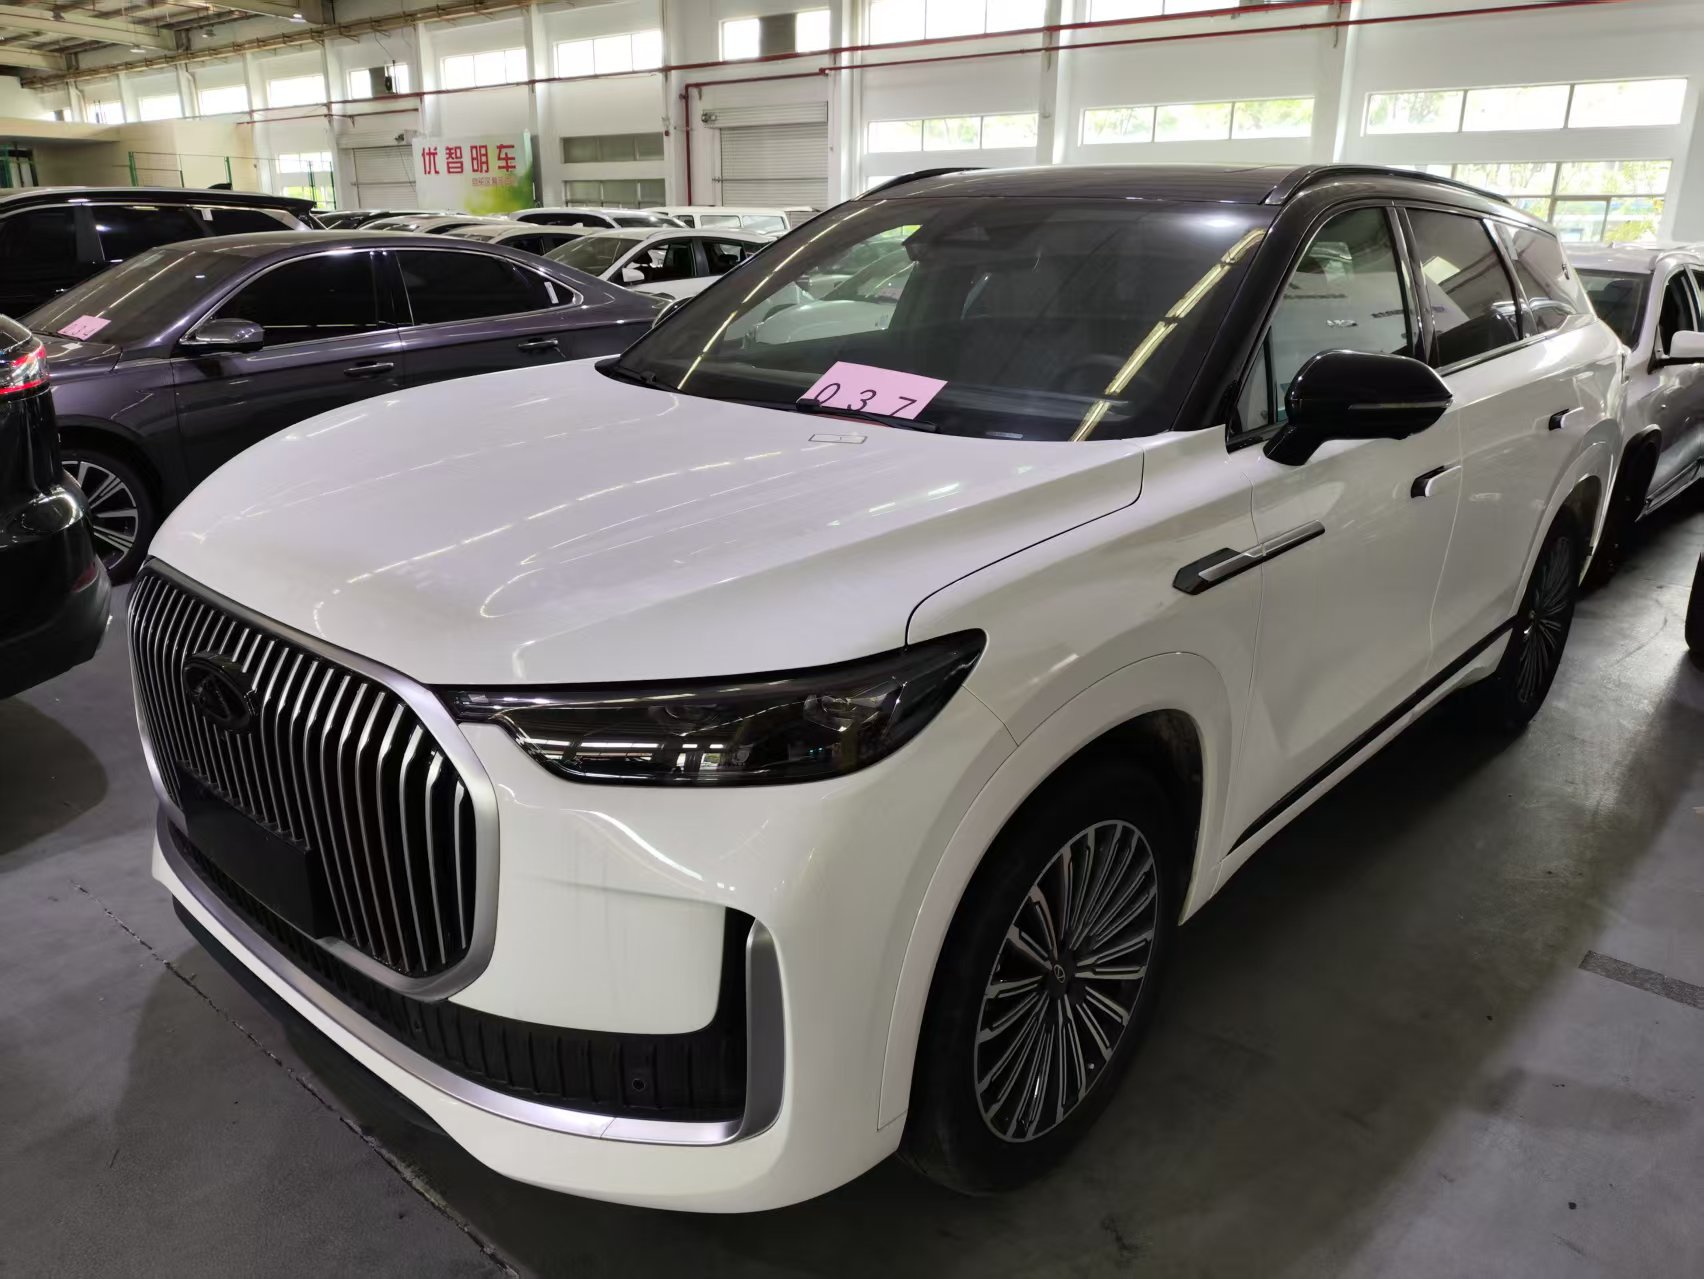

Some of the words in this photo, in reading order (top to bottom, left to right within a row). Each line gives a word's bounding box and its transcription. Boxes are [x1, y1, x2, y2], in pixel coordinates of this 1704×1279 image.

[421, 143, 516, 175] 优智明车
[813, 382, 918, 417] 037
